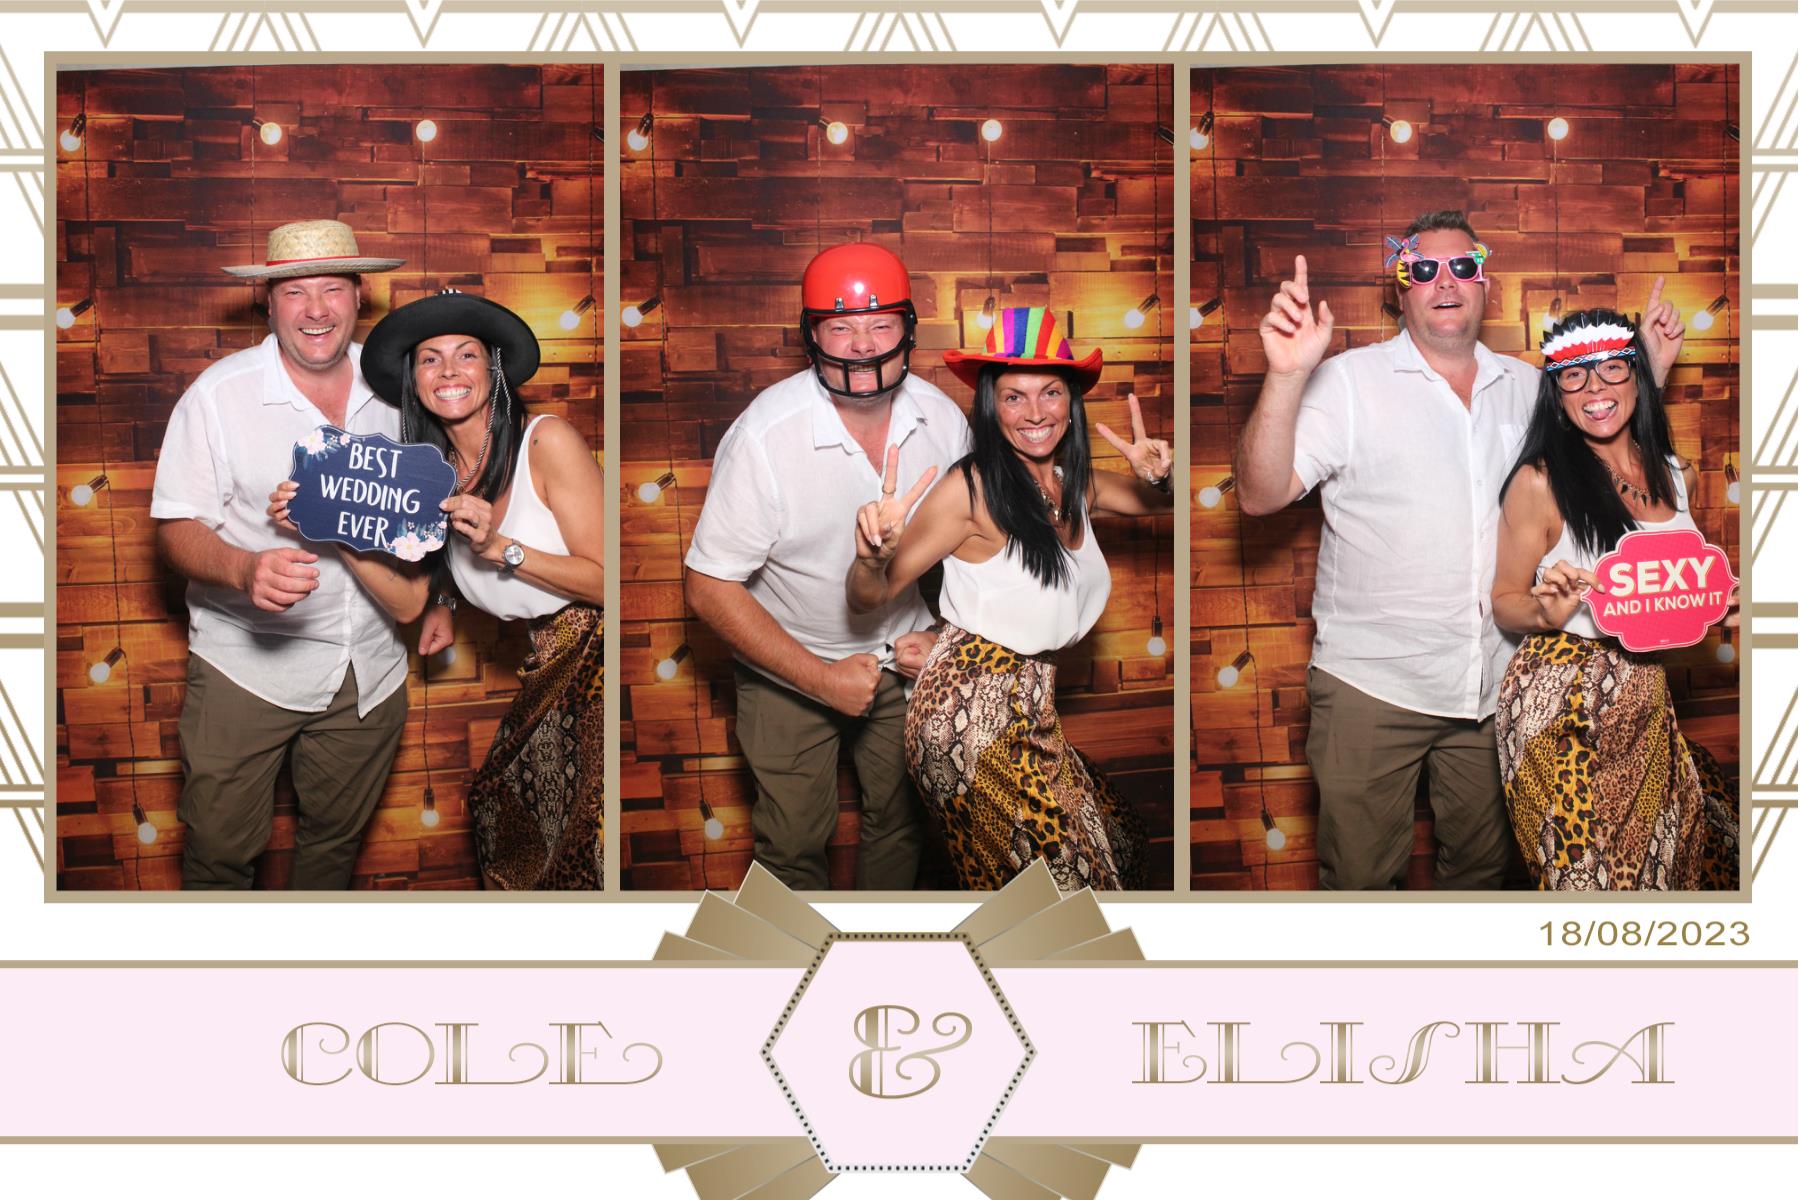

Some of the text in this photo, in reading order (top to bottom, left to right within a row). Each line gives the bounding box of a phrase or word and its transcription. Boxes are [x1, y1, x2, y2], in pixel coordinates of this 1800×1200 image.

[349, 443, 403, 478] BEST
[320, 473, 421, 514] WEDDING
[337, 511, 389, 548] EVER
[1609, 555, 1716, 598] SEXY
[1603, 591, 1724, 617] AND I KNOW IT
